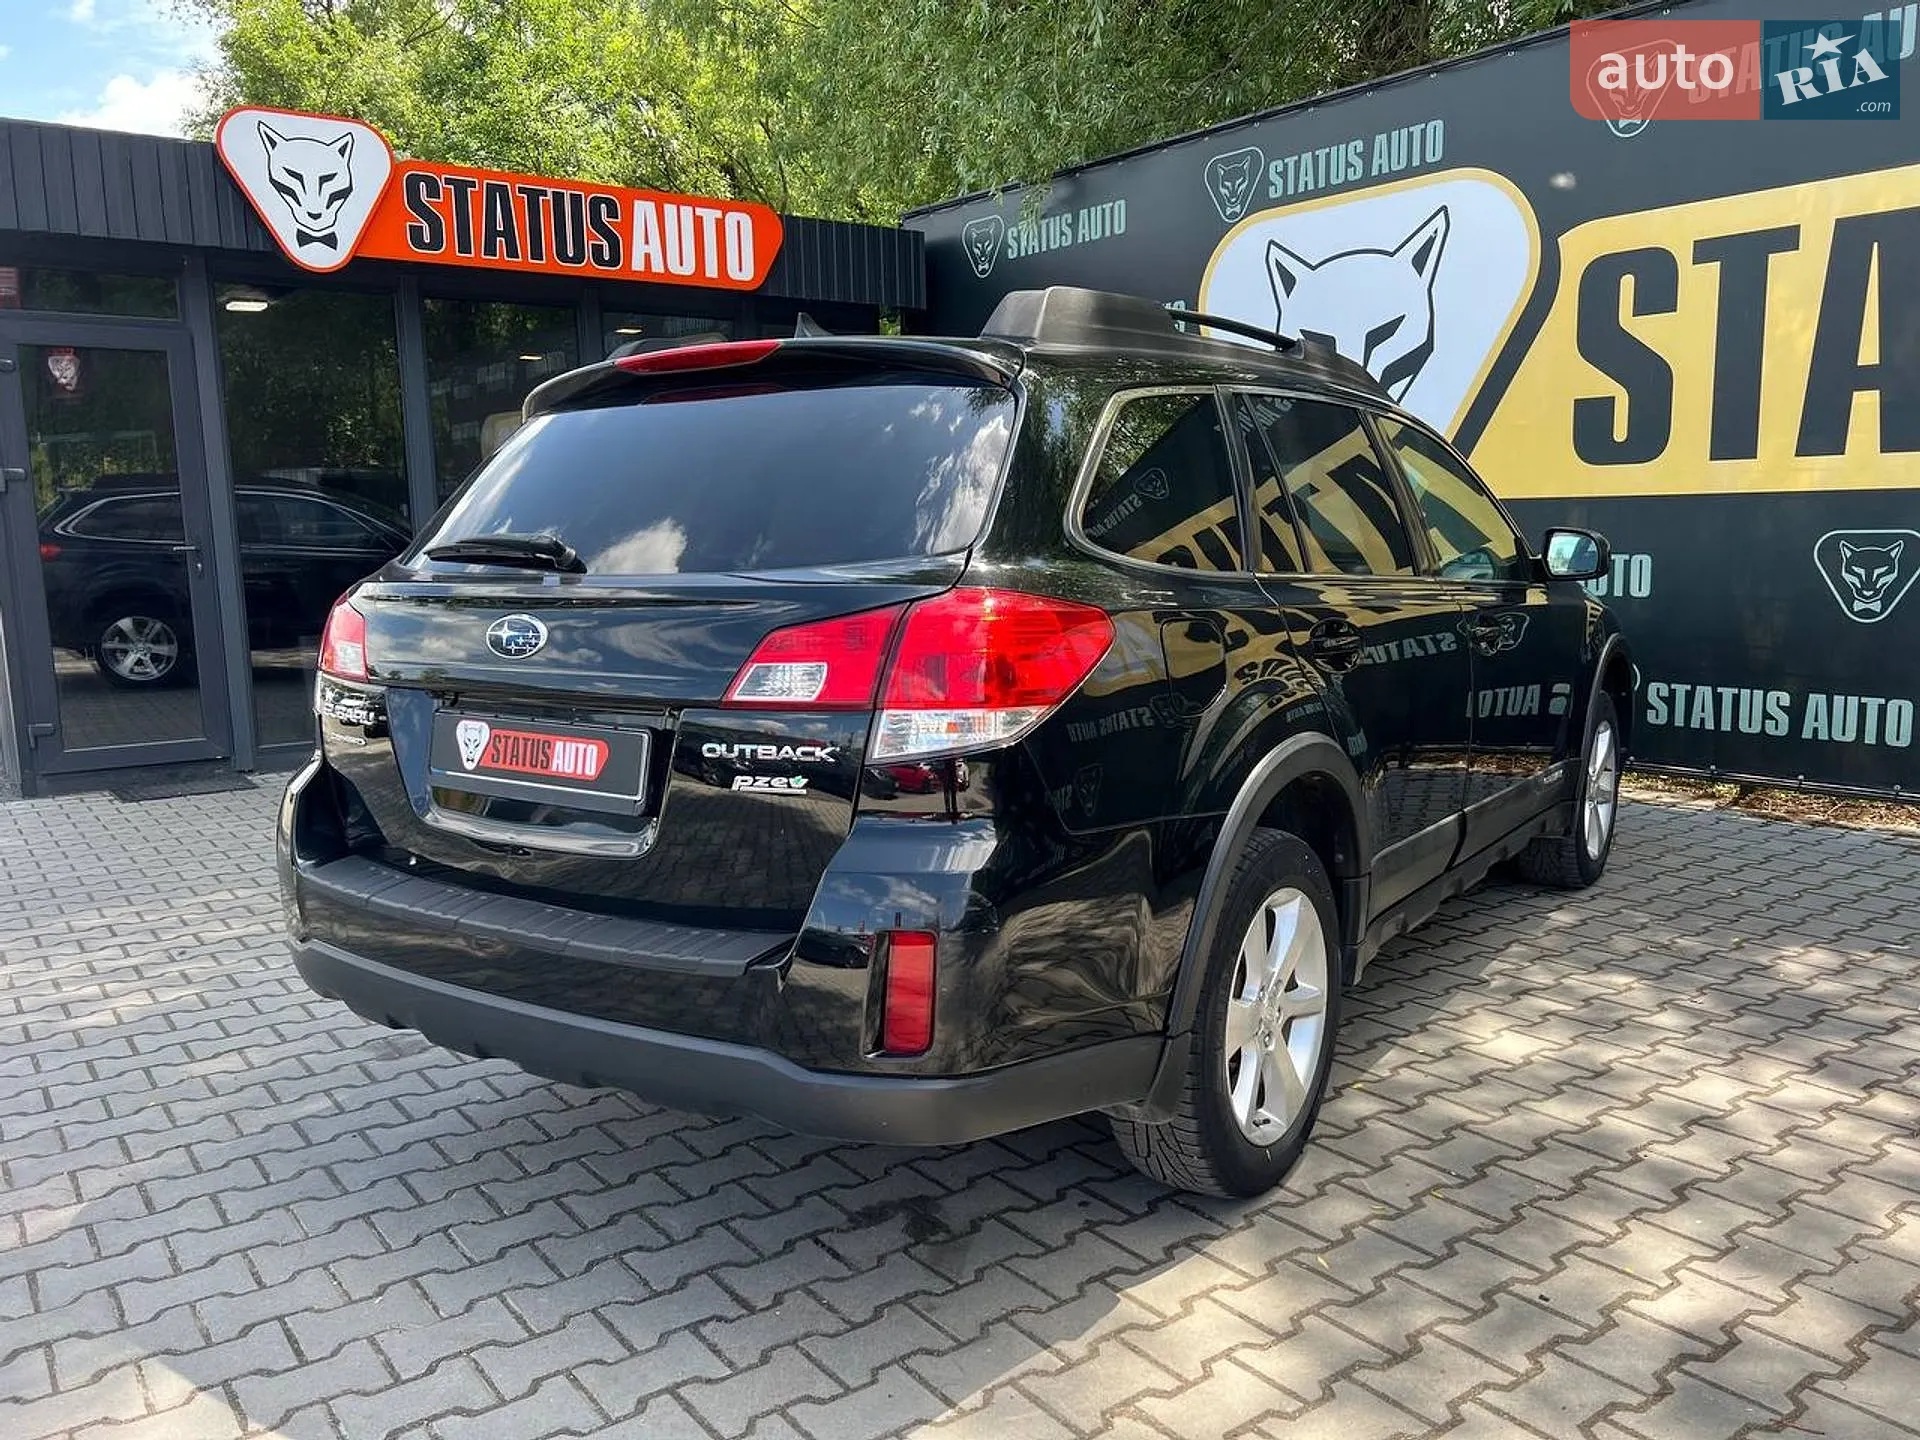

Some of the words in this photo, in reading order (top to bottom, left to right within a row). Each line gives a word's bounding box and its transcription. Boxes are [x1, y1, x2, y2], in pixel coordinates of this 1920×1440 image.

[1268, 139, 1364, 199] STATUS
[1371, 119, 1445, 176] AUTO
[404, 170, 622, 271] STATUS
[631, 199, 755, 282] AUTO
[1007, 213, 1072, 259] STATUS
[1078, 199, 1126, 243] AUTO
[1576, 553, 1652, 598] TO
[1647, 682, 1791, 737] STATUS
[1802, 693, 1914, 748] AUTO
[491, 734, 551, 770] STATUS
[551, 741, 599, 776] AUTO
[701, 743, 839, 762] OUTBACK
